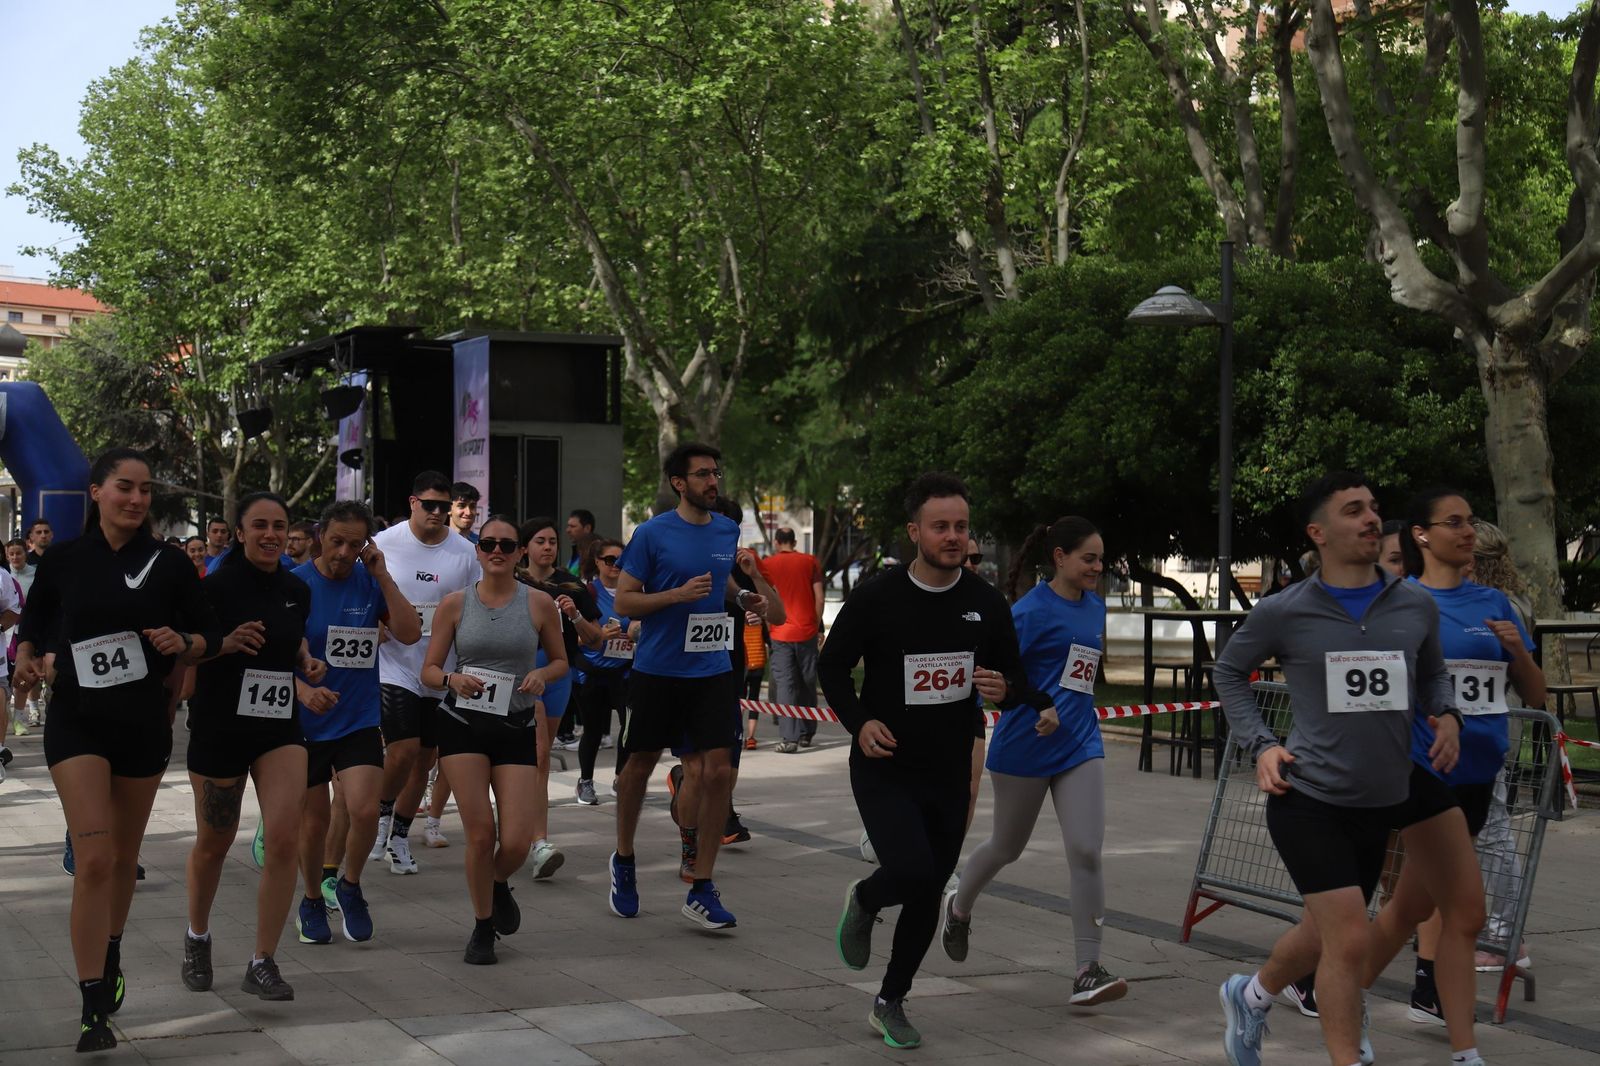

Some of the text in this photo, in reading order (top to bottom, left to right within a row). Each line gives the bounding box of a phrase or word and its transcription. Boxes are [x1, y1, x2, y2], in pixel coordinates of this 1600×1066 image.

[93, 638, 117, 648] CASTILLA
[690, 624, 723, 642] 220
[331, 638, 373, 658] 233
[91, 647, 130, 676] 84
[914, 668, 966, 691] 264
[1346, 668, 1390, 697] 98
[248, 683, 290, 707] 149
